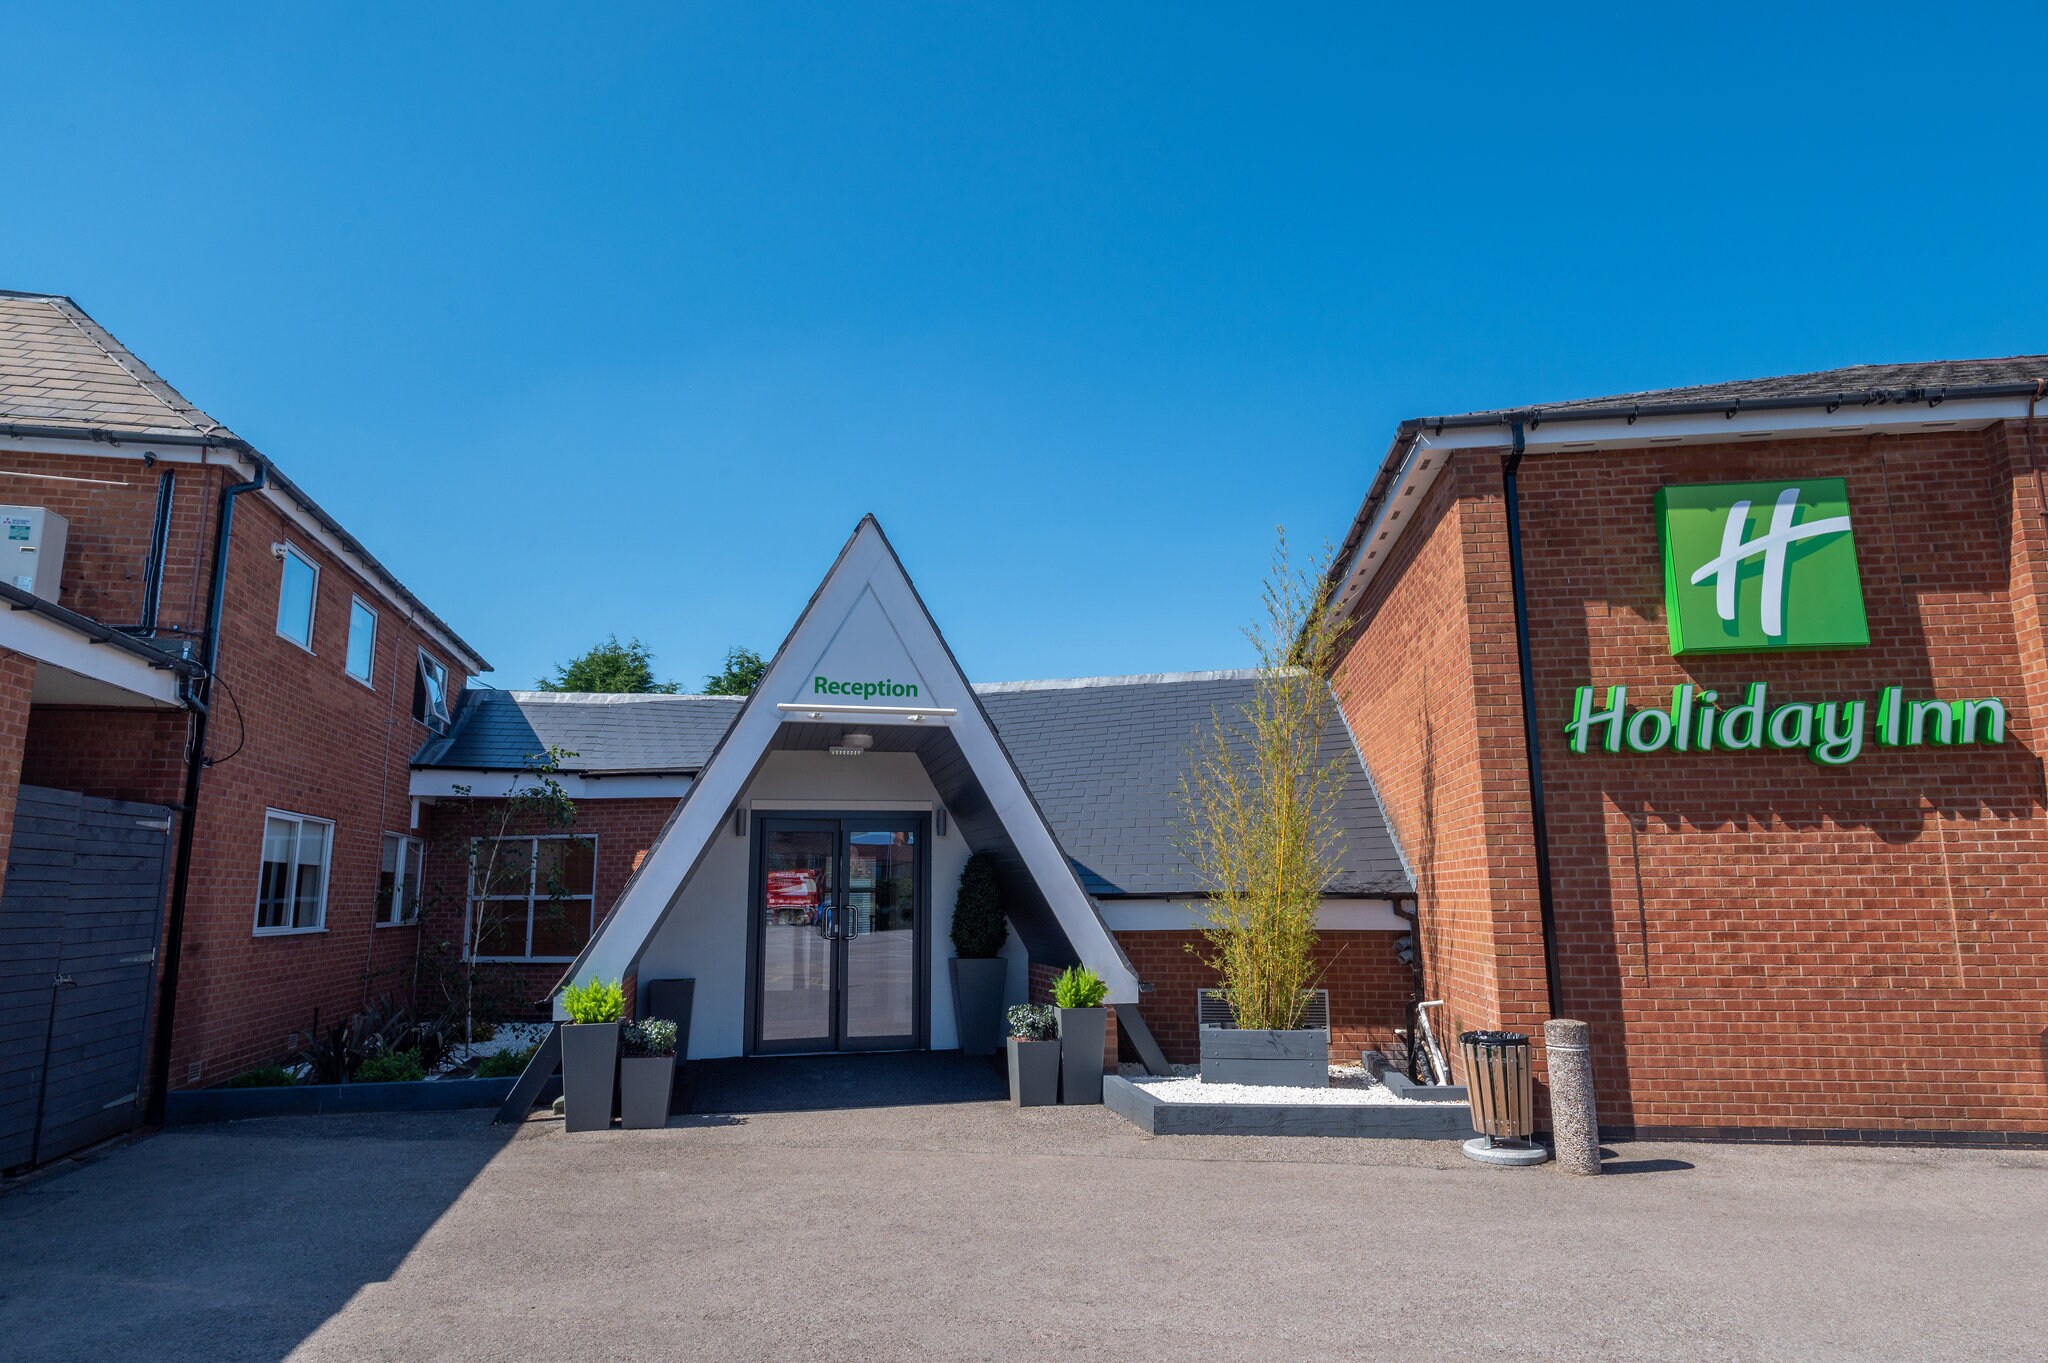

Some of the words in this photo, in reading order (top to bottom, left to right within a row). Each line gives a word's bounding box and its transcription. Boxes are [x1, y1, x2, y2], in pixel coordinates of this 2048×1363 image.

[1691, 488, 1851, 636] H
[814, 676, 918, 700] Reception
[1565, 682, 1866, 765] Holiday
[1876, 686, 2005, 747] Inn
